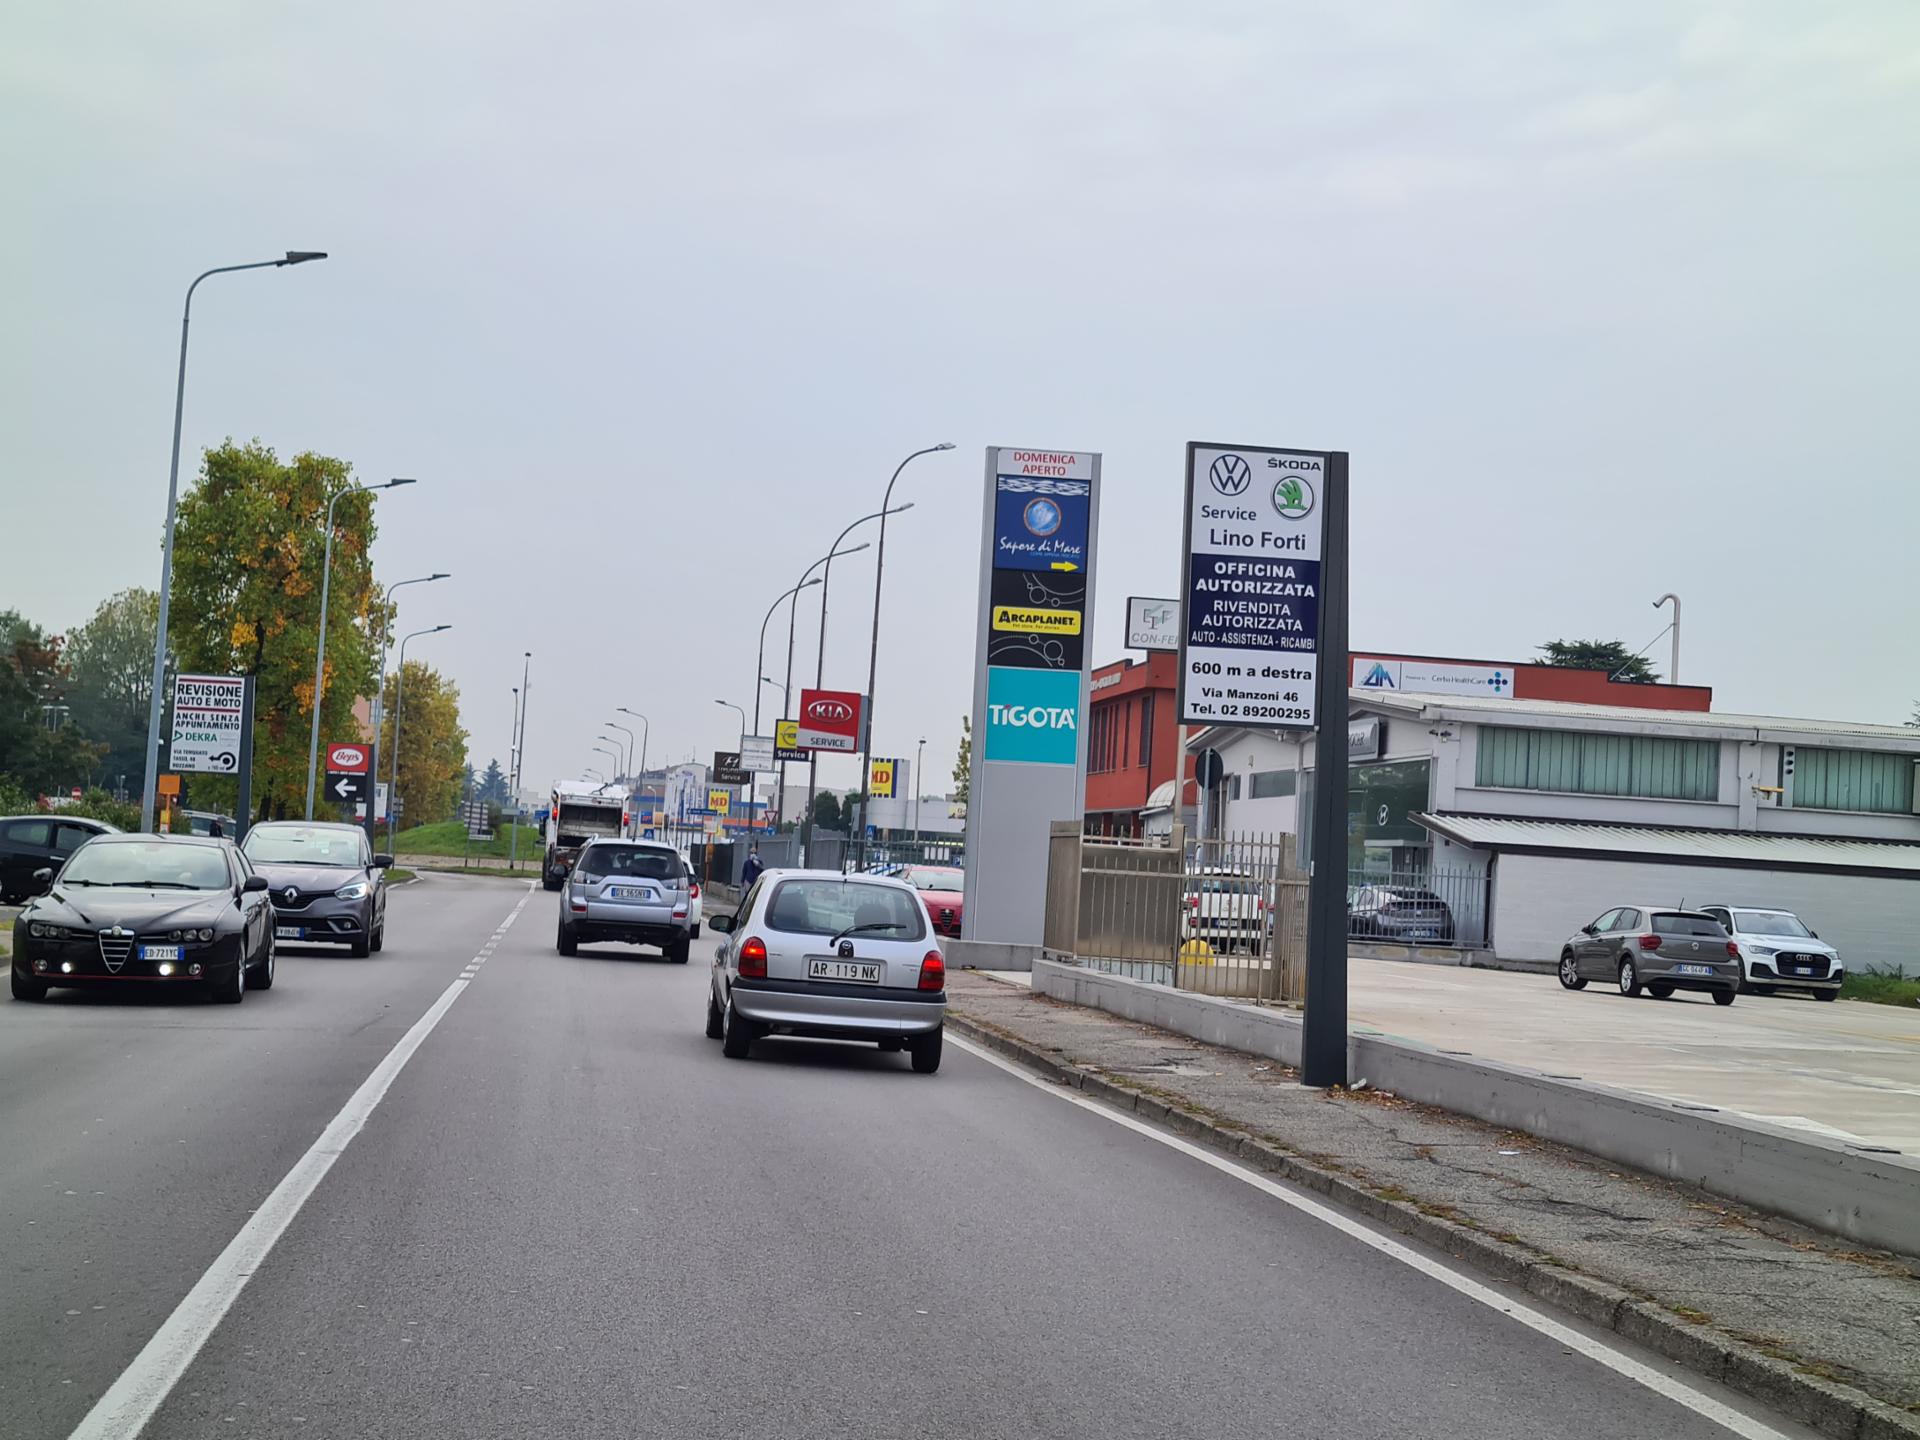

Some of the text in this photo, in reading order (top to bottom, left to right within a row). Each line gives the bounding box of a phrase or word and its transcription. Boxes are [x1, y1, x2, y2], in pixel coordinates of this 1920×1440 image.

[1014, 452, 1076, 465] DOMENICA
[1022, 464, 1066, 476] APERTO
[1201, 505, 1256, 521] Service
[1000, 536, 1081, 554] Sapore di Mare
[1210, 528, 1306, 550] Lino Forti
[1214, 562, 1296, 578] OFFICINA
[1196, 578, 1315, 598] AUTORIZZATA
[1214, 600, 1291, 616] RIVENDITA
[999, 611, 1074, 626] ARCAPLANET
[1202, 614, 1303, 631] AUTORIZZATA
[1192, 630, 1216, 643] AUTO
[1222, 632, 1274, 646] ASSISTENZA
[1280, 637, 1315, 650] RICAMBI
[1192, 662, 1312, 680] 600 m a destra
[177, 684, 242, 698] REVISIONE
[1202, 688, 1298, 702] Via Manzoni 46
[177, 696, 241, 708] AUTO E MOTO
[176, 712, 240, 722] ANCHE SENZA
[816, 704, 844, 718] KIA
[1190, 702, 1310, 720] Tel. 02 89200295
[175, 720, 240, 730] APPUNTAMENTO
[185, 732, 218, 742] DEKRA
[810, 738, 846, 748] SERVICE
[777, 750, 806, 759] Service
[813, 962, 876, 979] AR 119 NK
